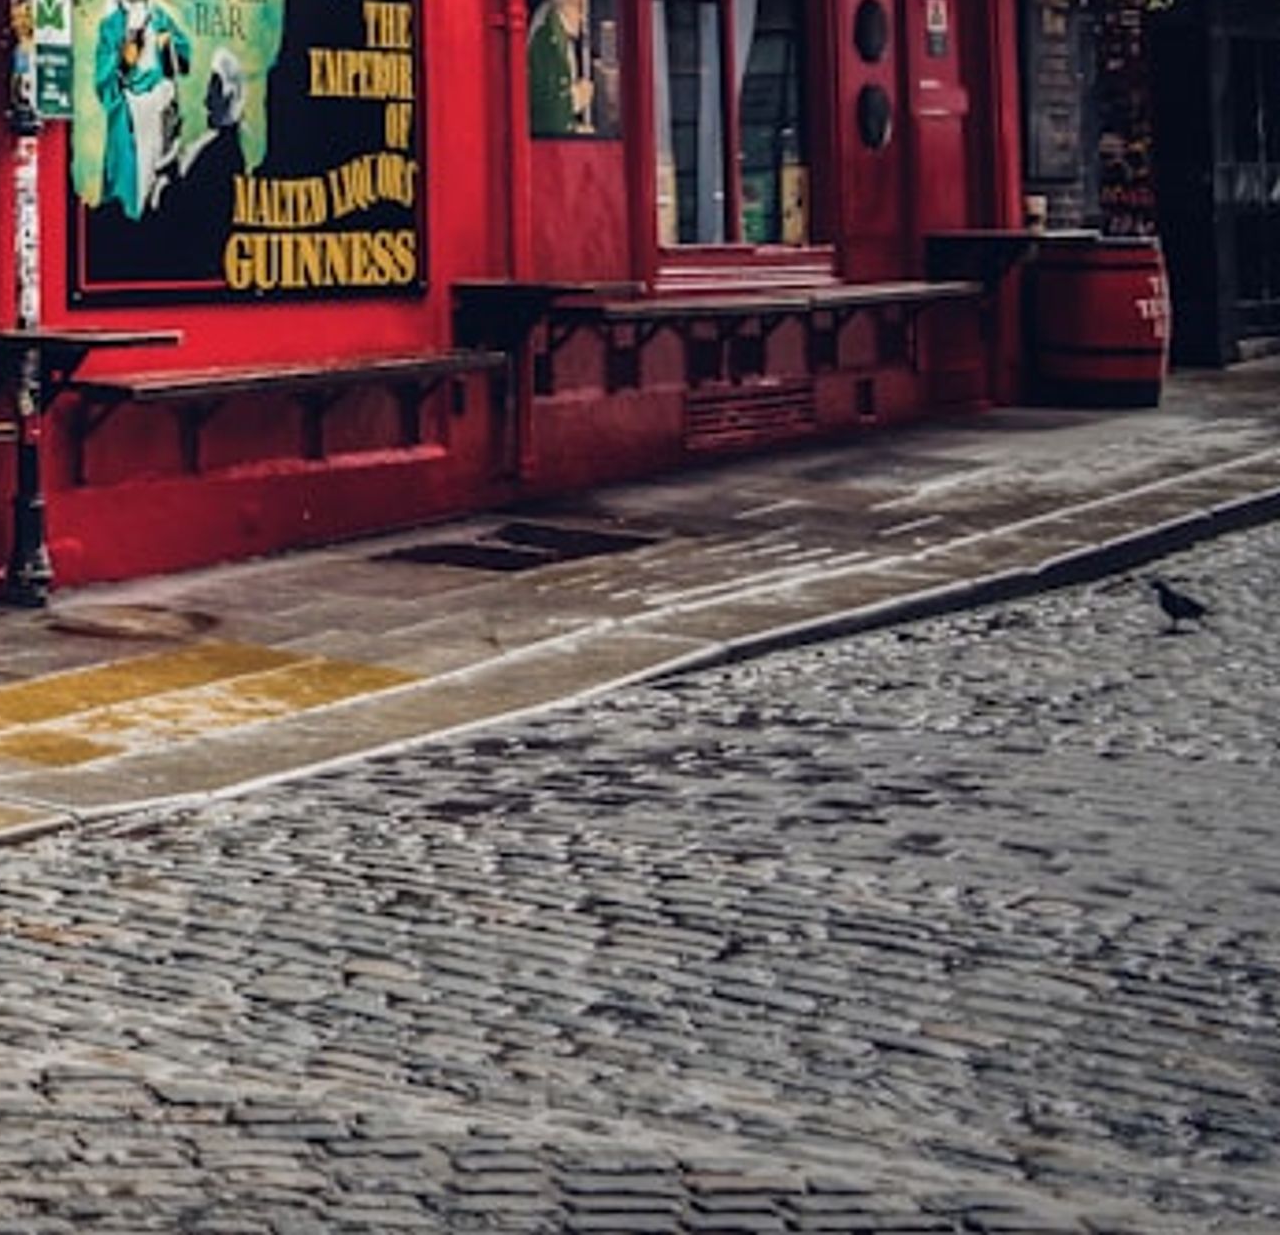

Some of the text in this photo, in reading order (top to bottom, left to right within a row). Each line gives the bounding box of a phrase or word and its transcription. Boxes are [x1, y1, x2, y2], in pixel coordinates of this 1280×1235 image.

[194, 2, 246, 41] BAR
[308, 47, 414, 100] EMPEROR
[385, 102, 413, 150] OF
[232, 151, 420, 228] MALTED LIQUORS
[225, 228, 417, 291] GUINNESS
